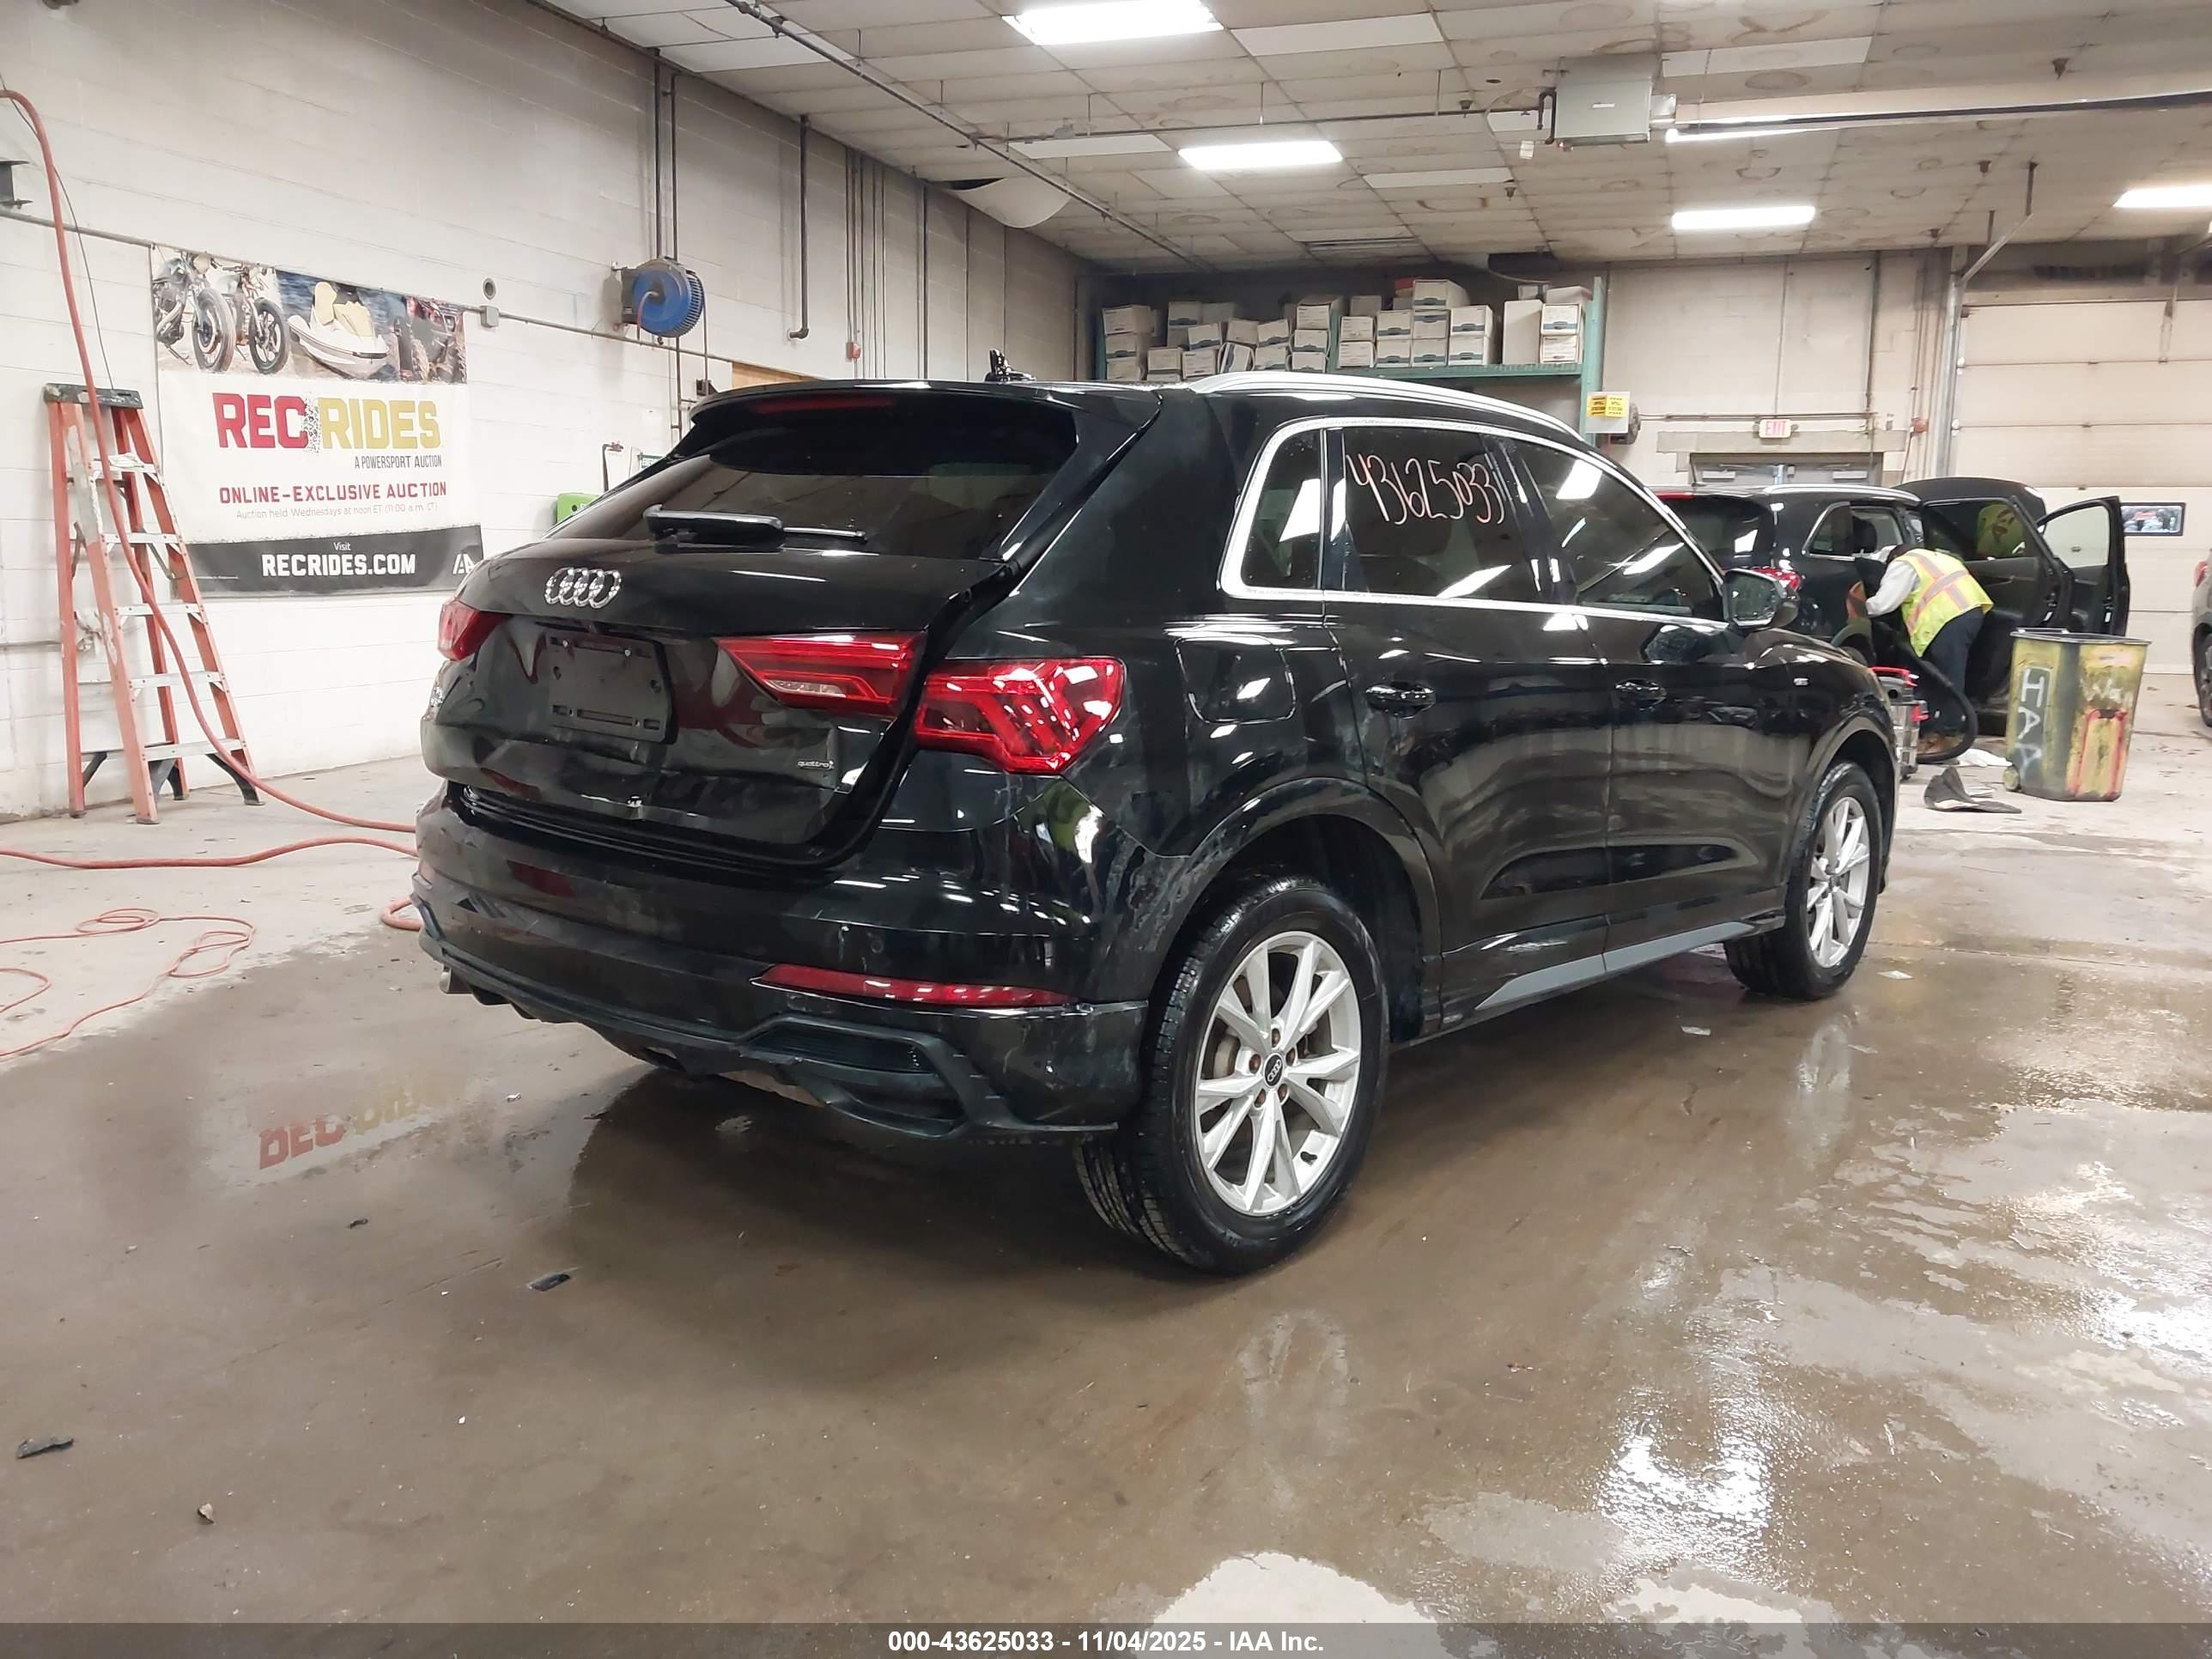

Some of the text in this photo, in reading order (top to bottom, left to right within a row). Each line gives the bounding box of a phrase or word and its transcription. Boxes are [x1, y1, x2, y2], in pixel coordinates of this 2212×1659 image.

[213, 392, 441, 450] REC RIDES
[1765, 420, 1787, 436] EXIT
[355, 454, 442, 469] A POWERSPORT AUCTION
[219, 481, 447, 504] ONLINE-EXCLUSIVE AUCTION
[1346, 453, 1504, 525] 43625033
[236, 509, 267, 520] Auction
[269, 508, 289, 518] held
[290, 507, 342, 517] Wednesdays
[343, 506, 352, 515] at
[354, 506, 372, 514] noon
[373, 504, 384, 514] ET
[332, 542, 351, 551] Visit
[261, 554, 416, 577] RECRIDES.COM
